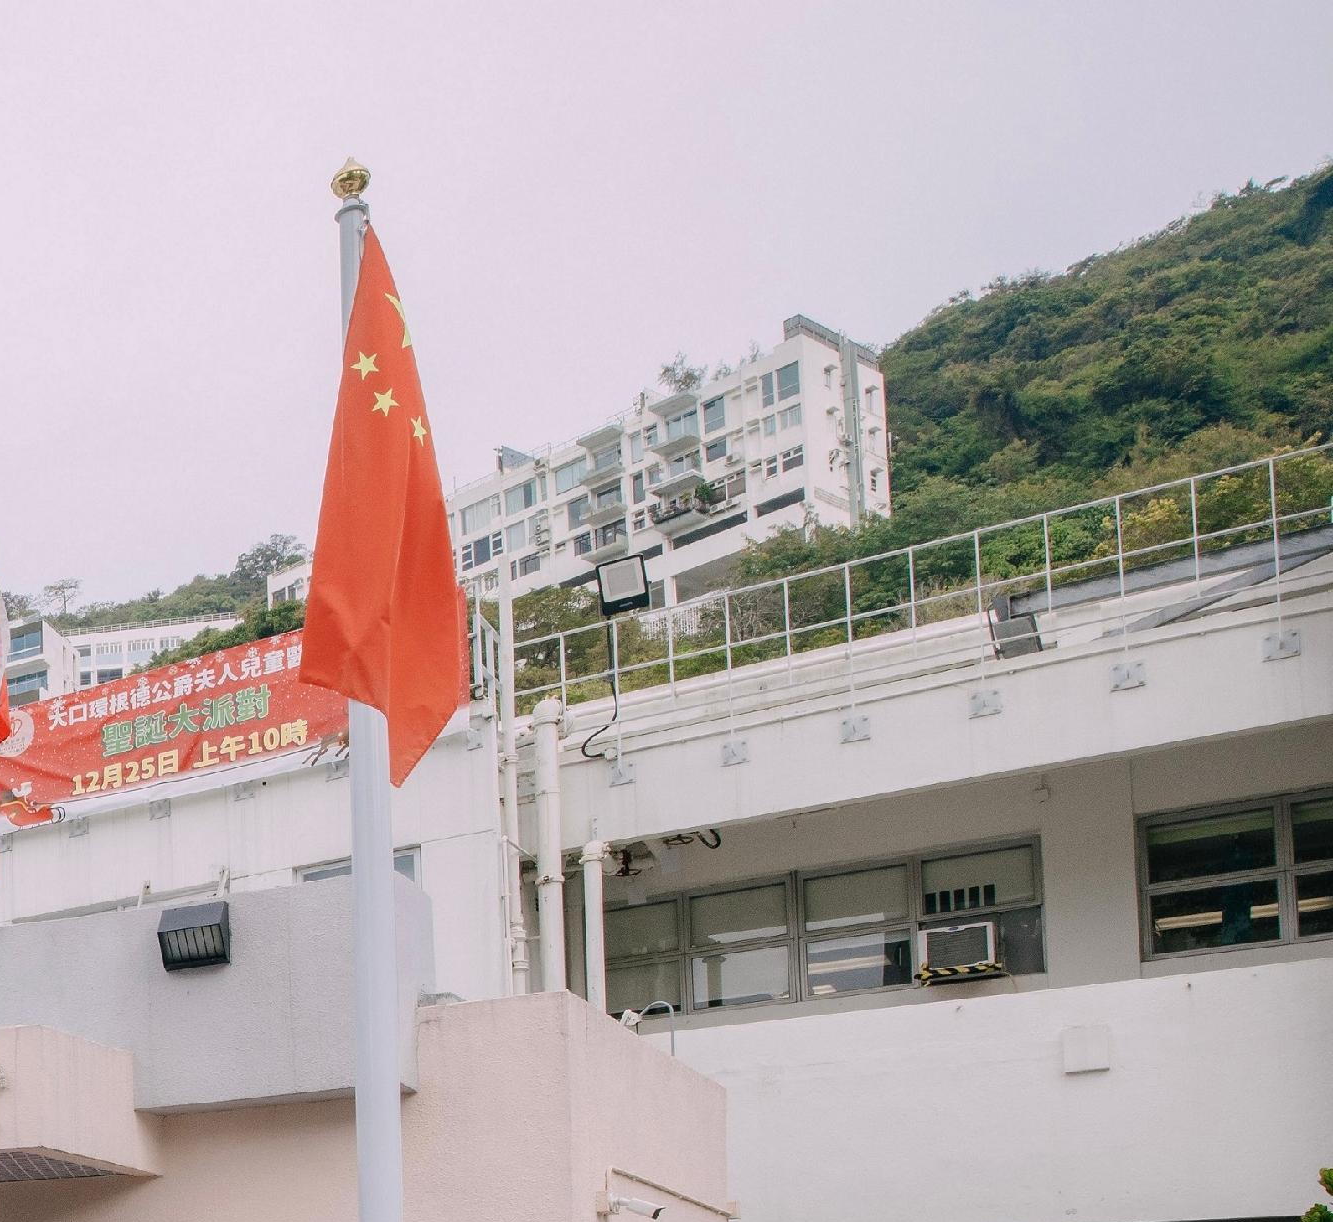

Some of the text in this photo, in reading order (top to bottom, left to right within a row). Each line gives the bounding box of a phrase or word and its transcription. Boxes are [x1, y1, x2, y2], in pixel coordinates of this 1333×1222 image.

[47, 644, 303, 731] 大口環根德公爵夫人兒童醫
[101, 684, 271, 758] 聖誕大派對
[71, 719, 309, 797] 12月25日 上午10時
